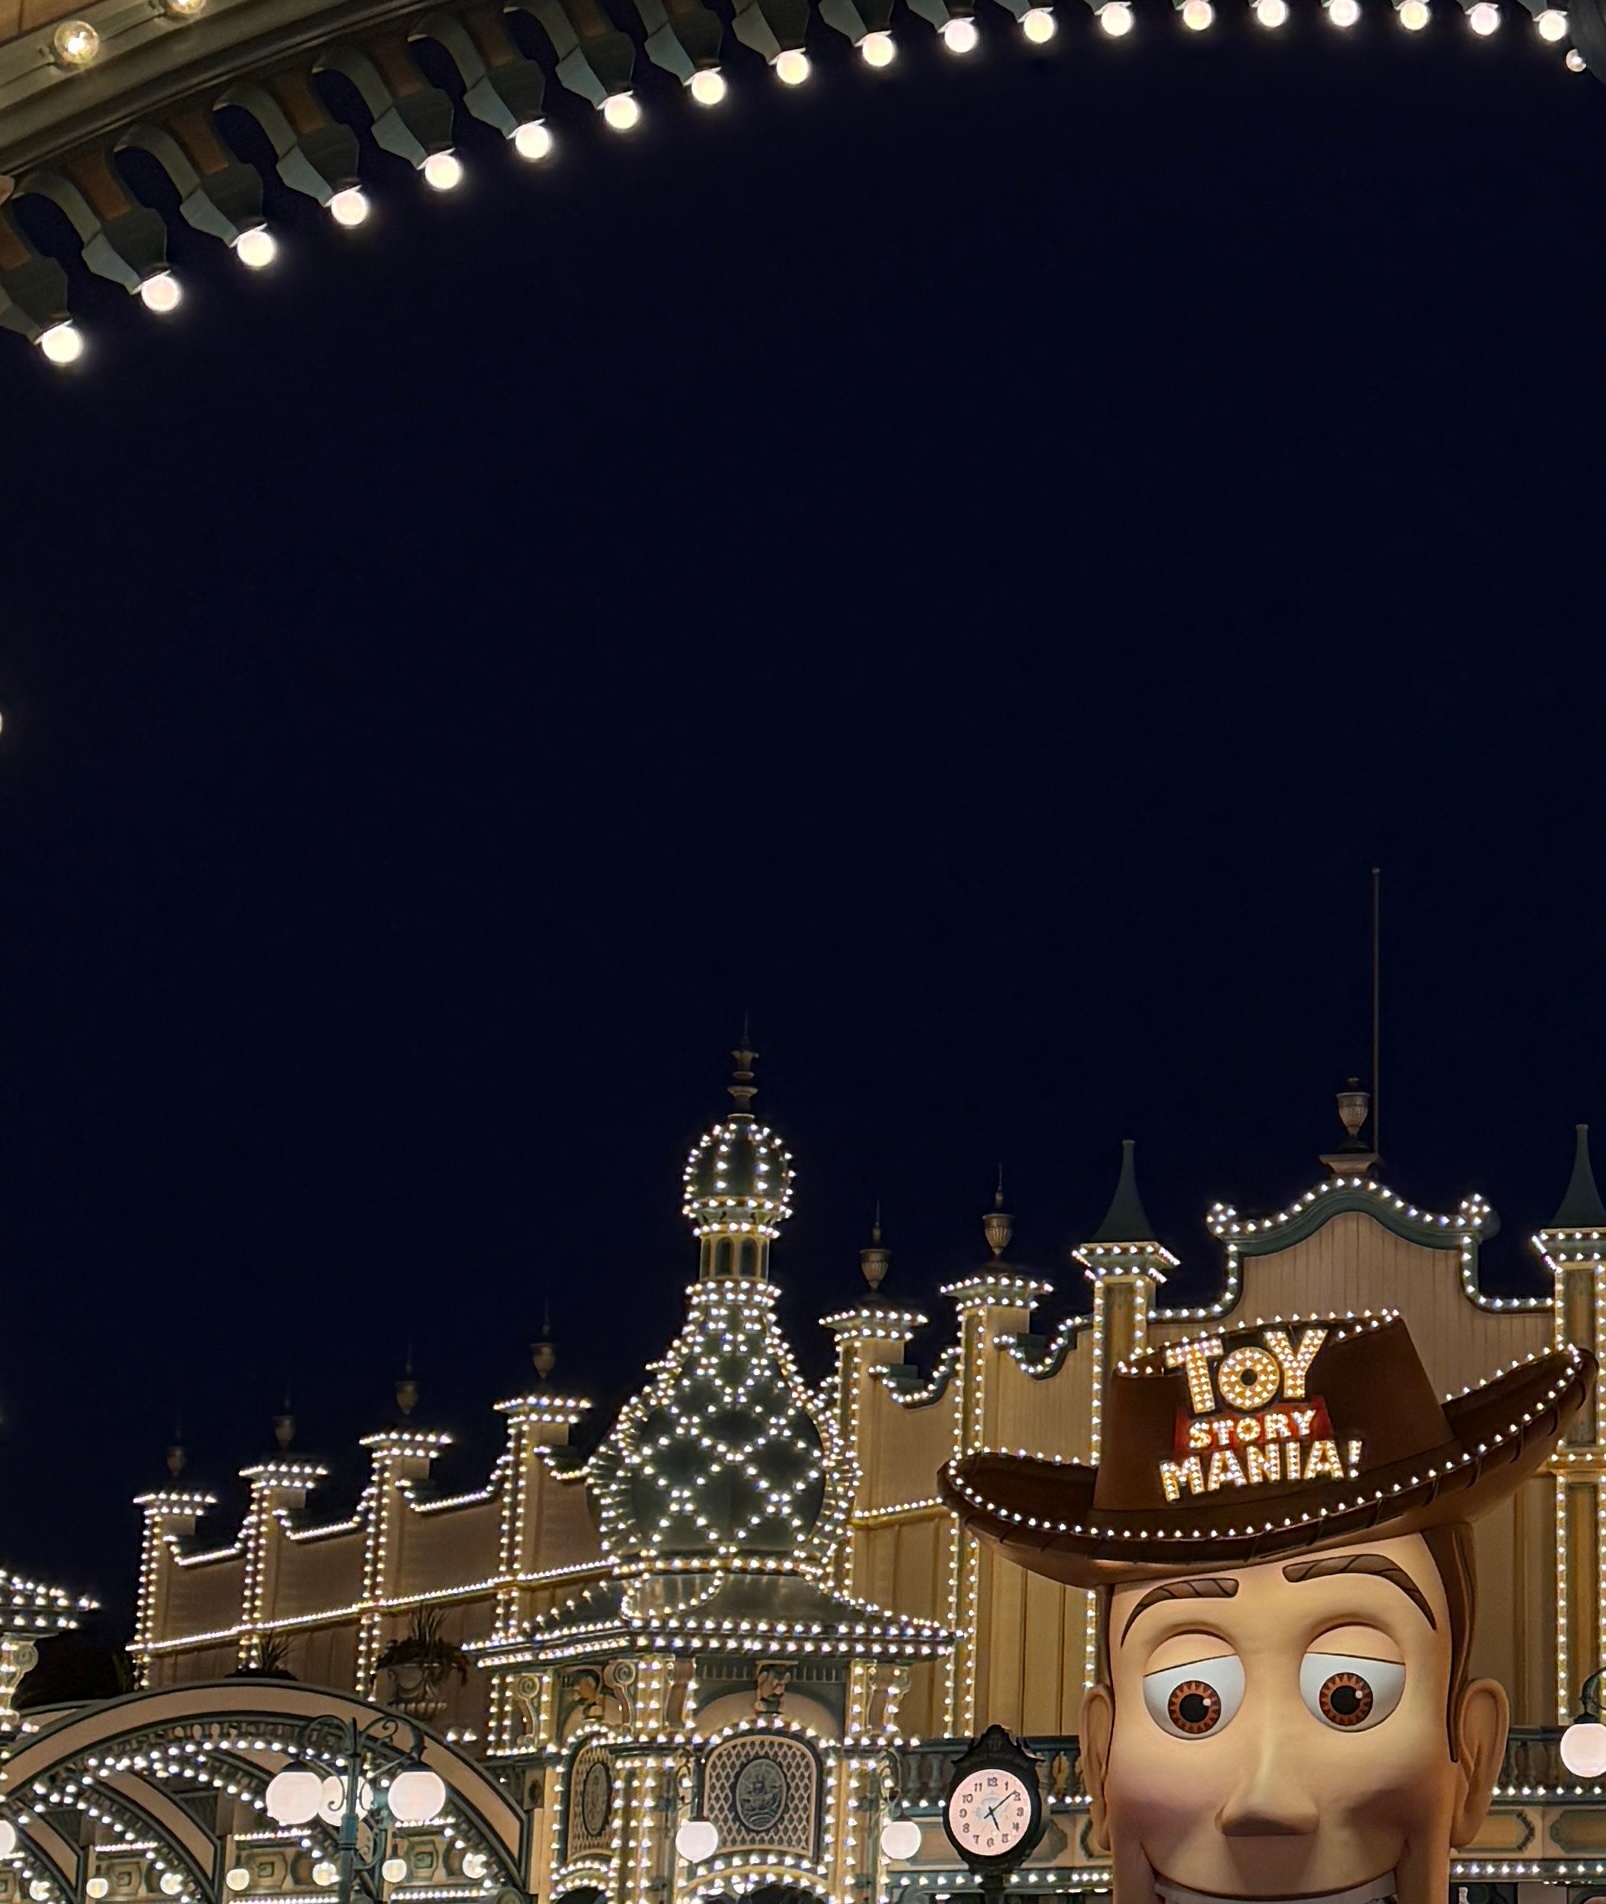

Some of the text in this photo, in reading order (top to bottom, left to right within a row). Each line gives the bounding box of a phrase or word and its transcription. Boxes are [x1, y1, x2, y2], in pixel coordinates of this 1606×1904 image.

[1165, 1328, 1329, 1414] TOY
[1189, 1409, 1316, 1449] STORY
[1159, 1440, 1363, 1502] MANIA!
[974, 1782, 983, 1792] 11
[987, 1777, 998, 1787] 12
[1004, 1781, 1009, 1791] 1
[963, 1793, 973, 1803] 10
[962, 1822, 970, 1833] 8
[973, 1834, 980, 1844] 7
[986, 1837, 994, 1847] 6
